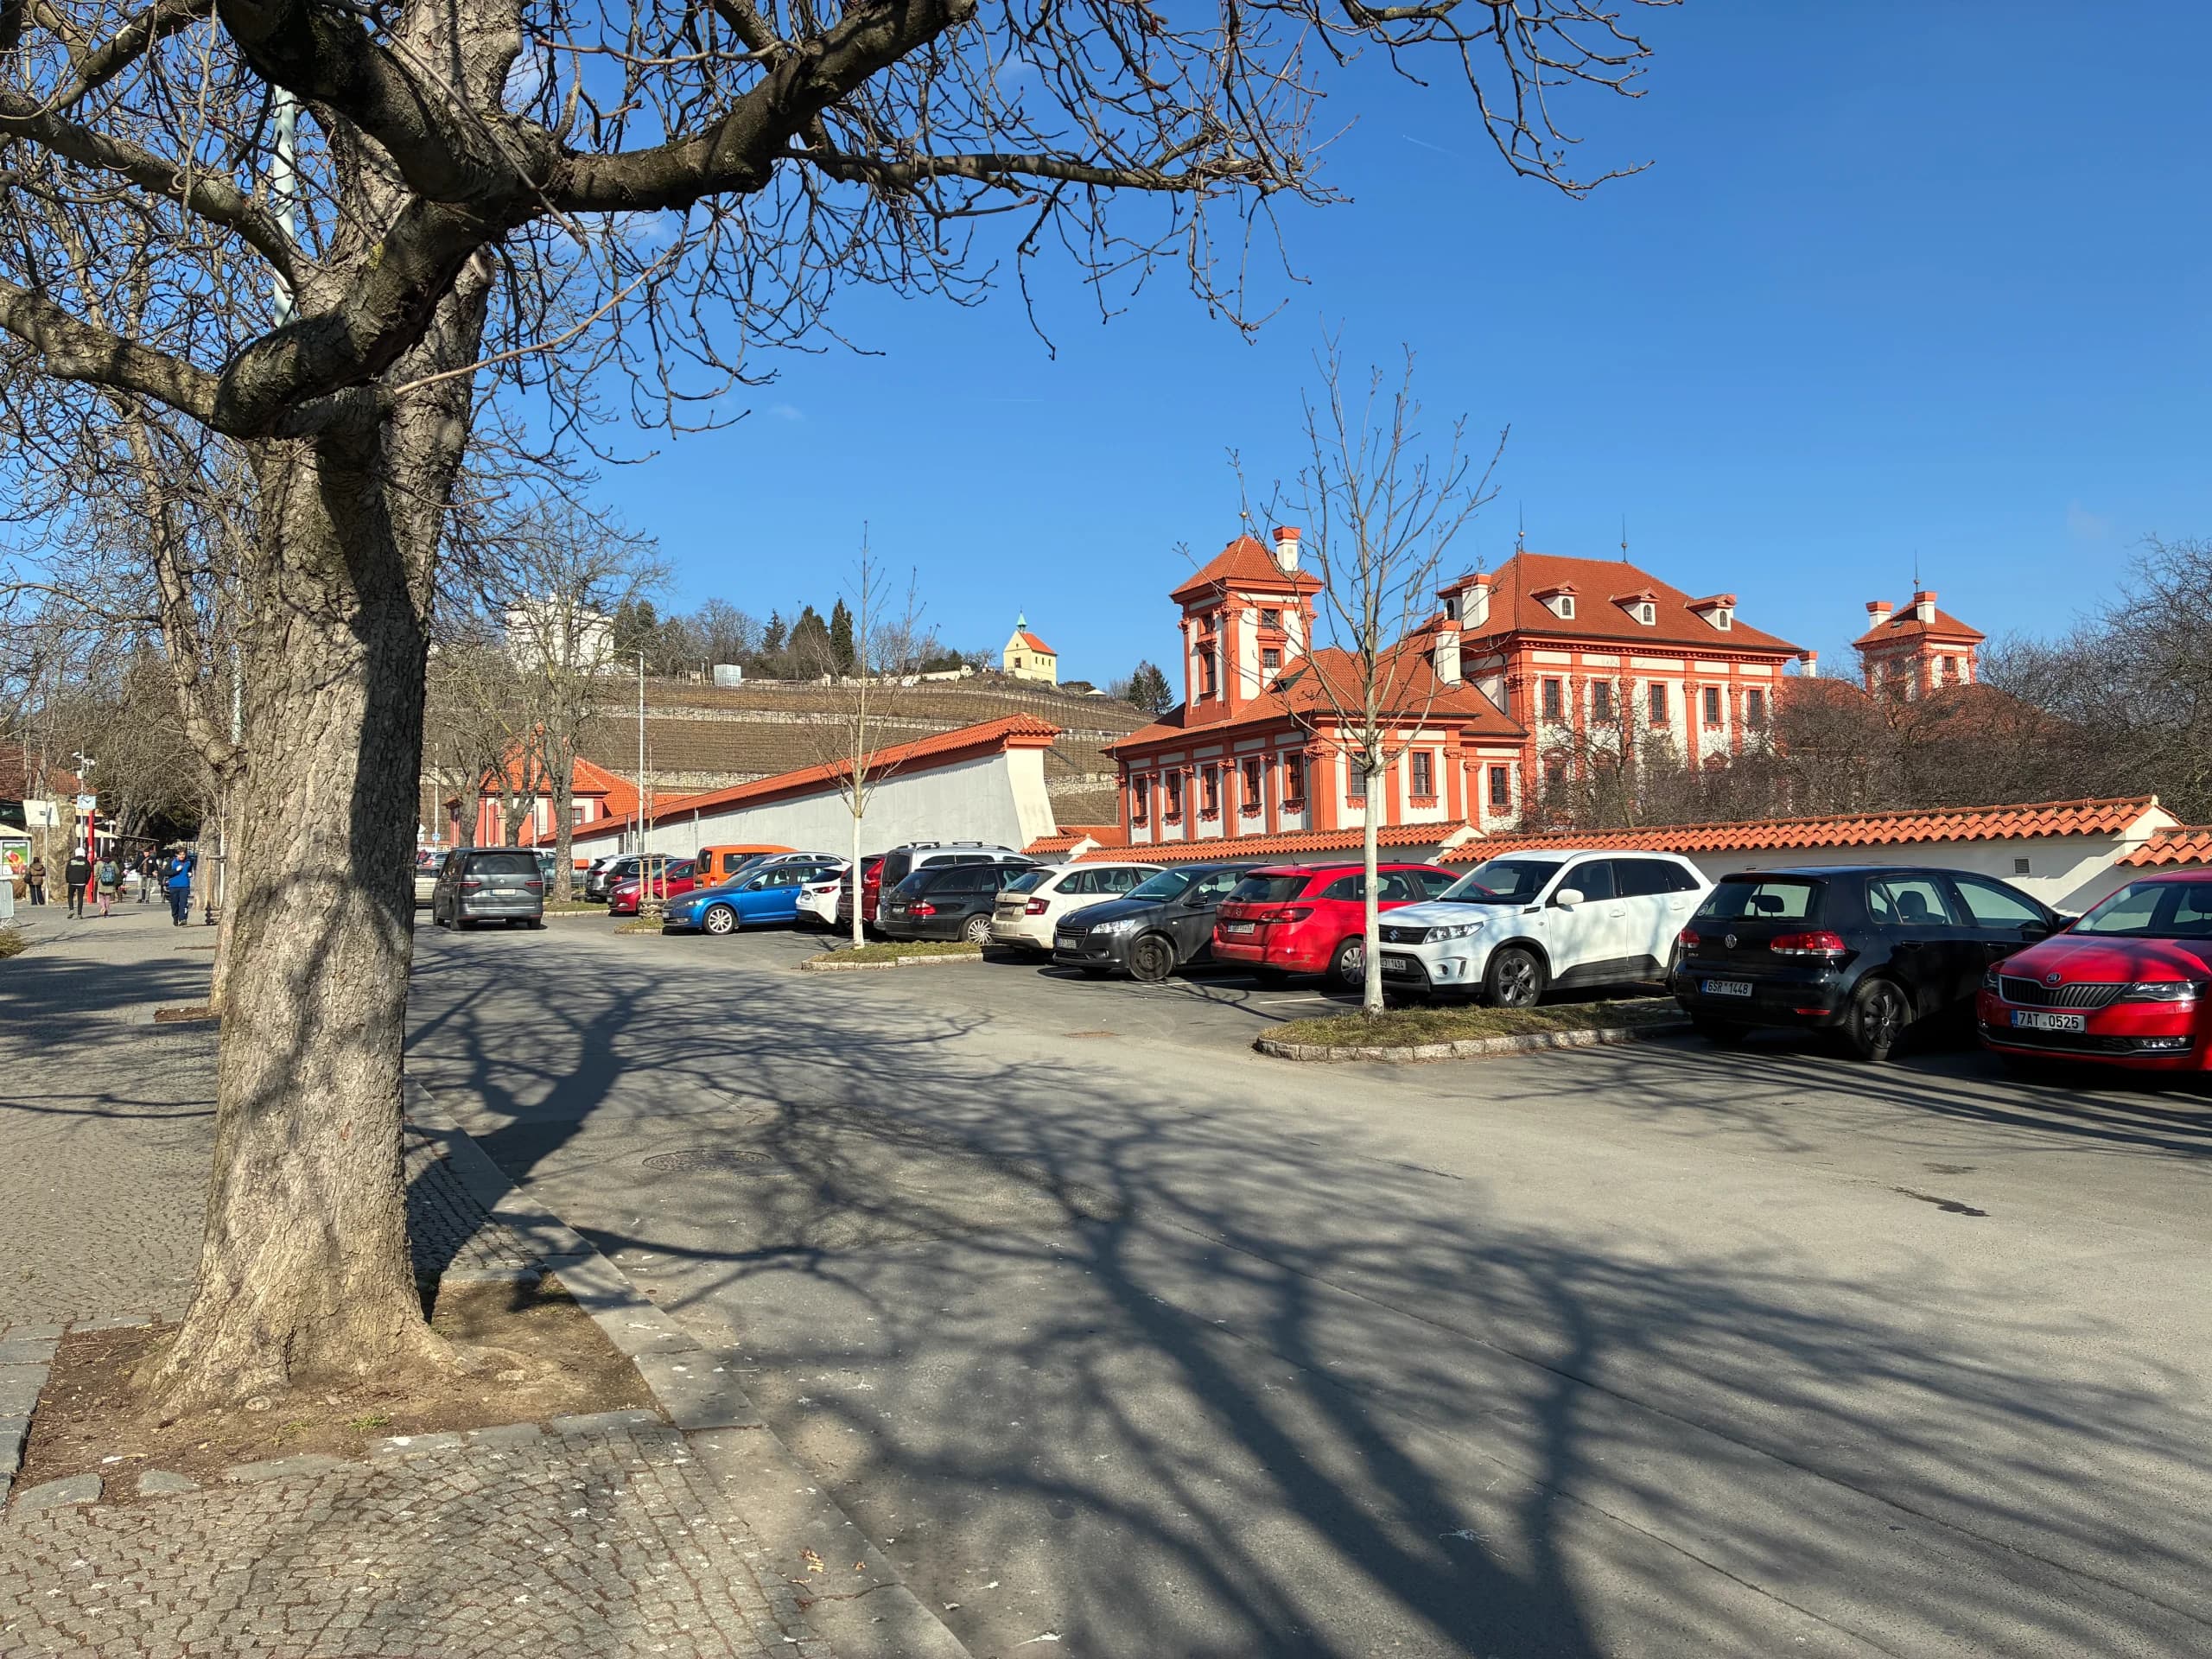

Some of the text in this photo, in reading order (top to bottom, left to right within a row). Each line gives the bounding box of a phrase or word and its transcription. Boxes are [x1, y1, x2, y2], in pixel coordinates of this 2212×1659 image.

[1707, 981, 1749, 995] 6SR 1448
[2018, 1012, 2079, 1029] 7AT 0525
